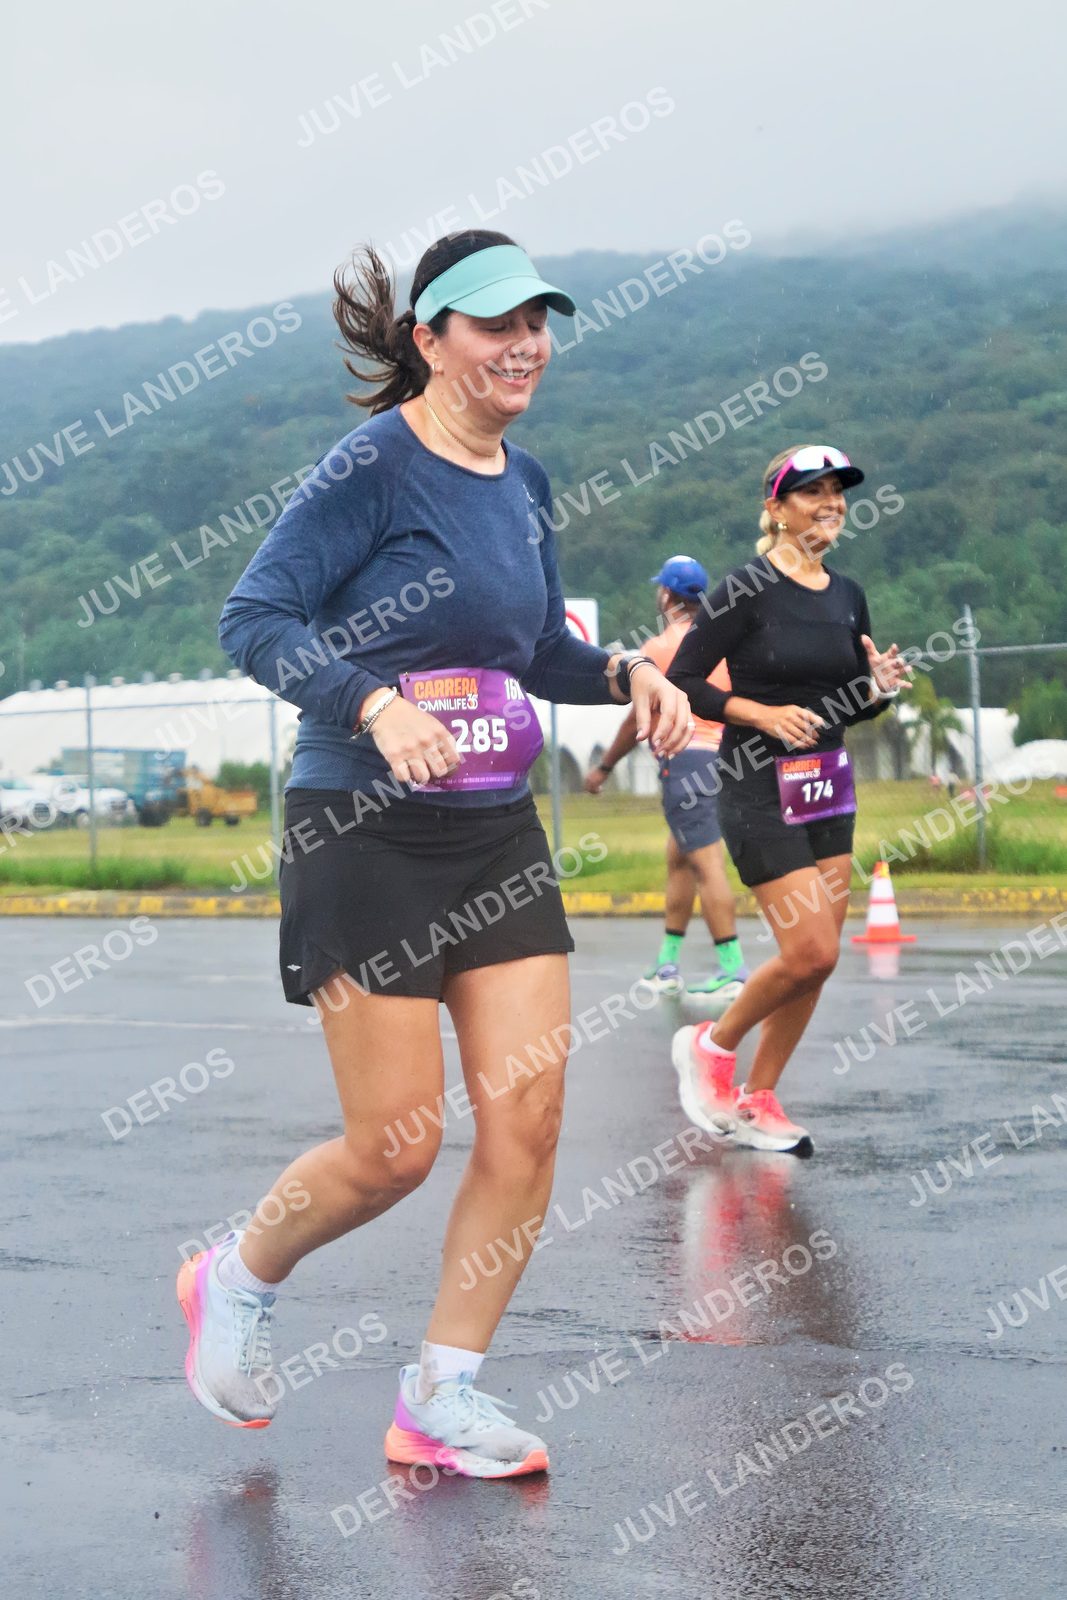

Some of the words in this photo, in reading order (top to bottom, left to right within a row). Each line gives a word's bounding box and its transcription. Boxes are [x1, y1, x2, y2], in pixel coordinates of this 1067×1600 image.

[415, 677, 478, 699] CARRERA
[451, 718, 508, 752] 285
[802, 779, 833, 803] 174
